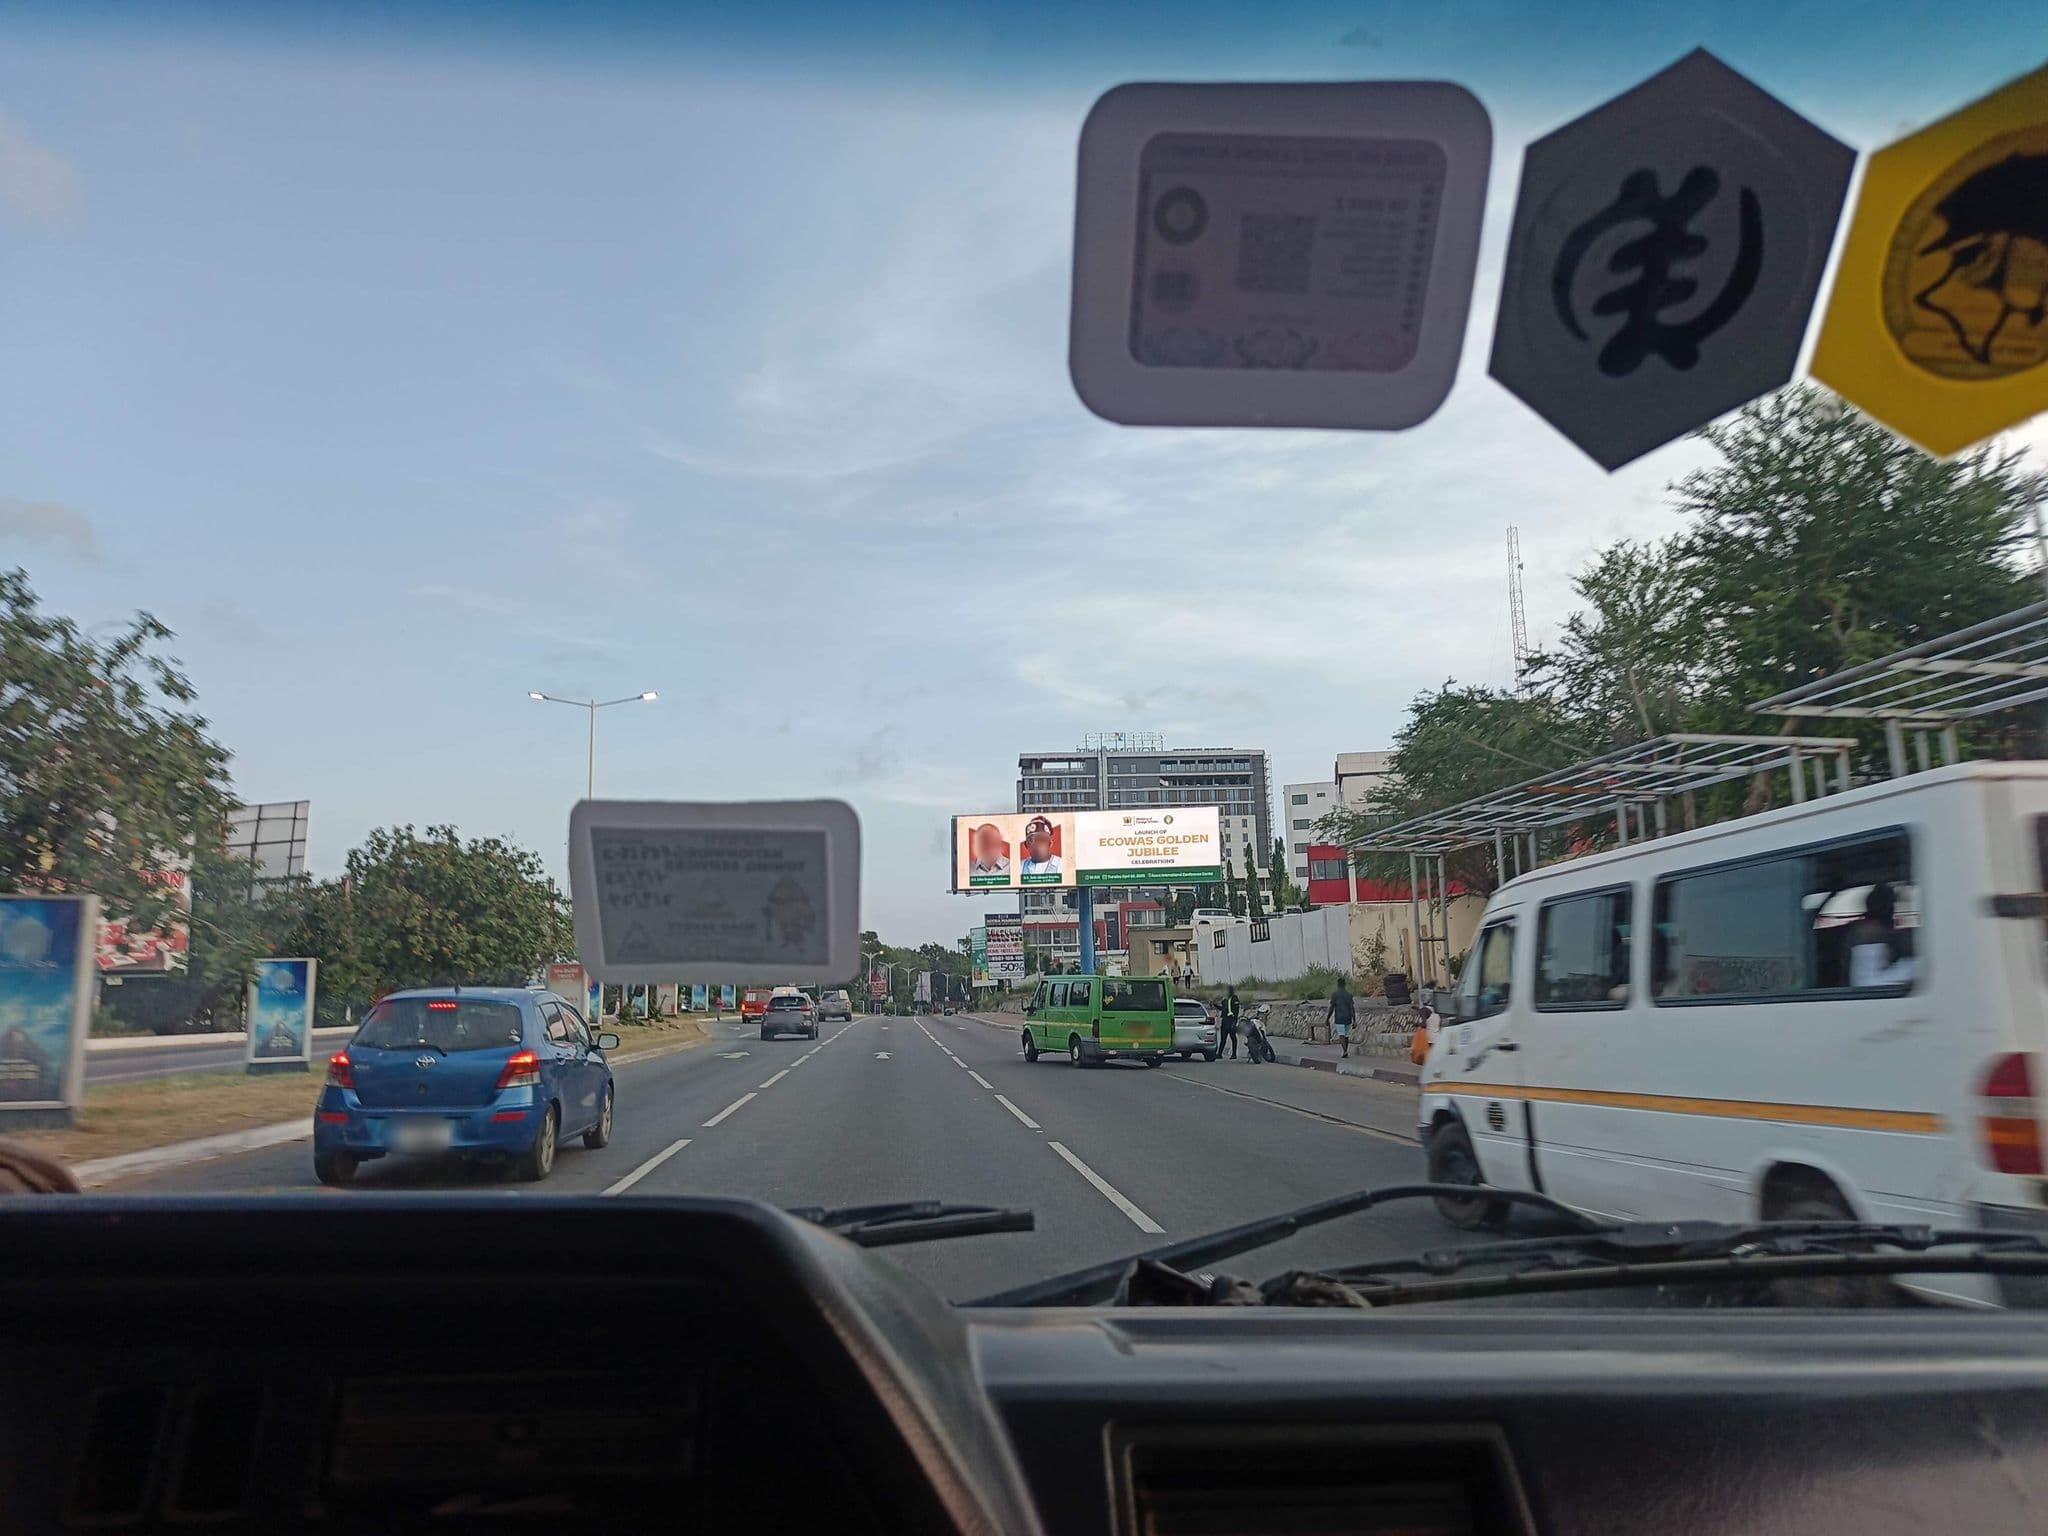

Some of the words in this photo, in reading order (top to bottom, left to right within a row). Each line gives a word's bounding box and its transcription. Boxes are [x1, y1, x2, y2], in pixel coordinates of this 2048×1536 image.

[1099, 837, 1154, 847] ECOWAS
[1156, 834, 1209, 844] GOLDEN
[1127, 846, 1179, 857] JUBILEE
[1000, 962, 1025, 972] 50%
